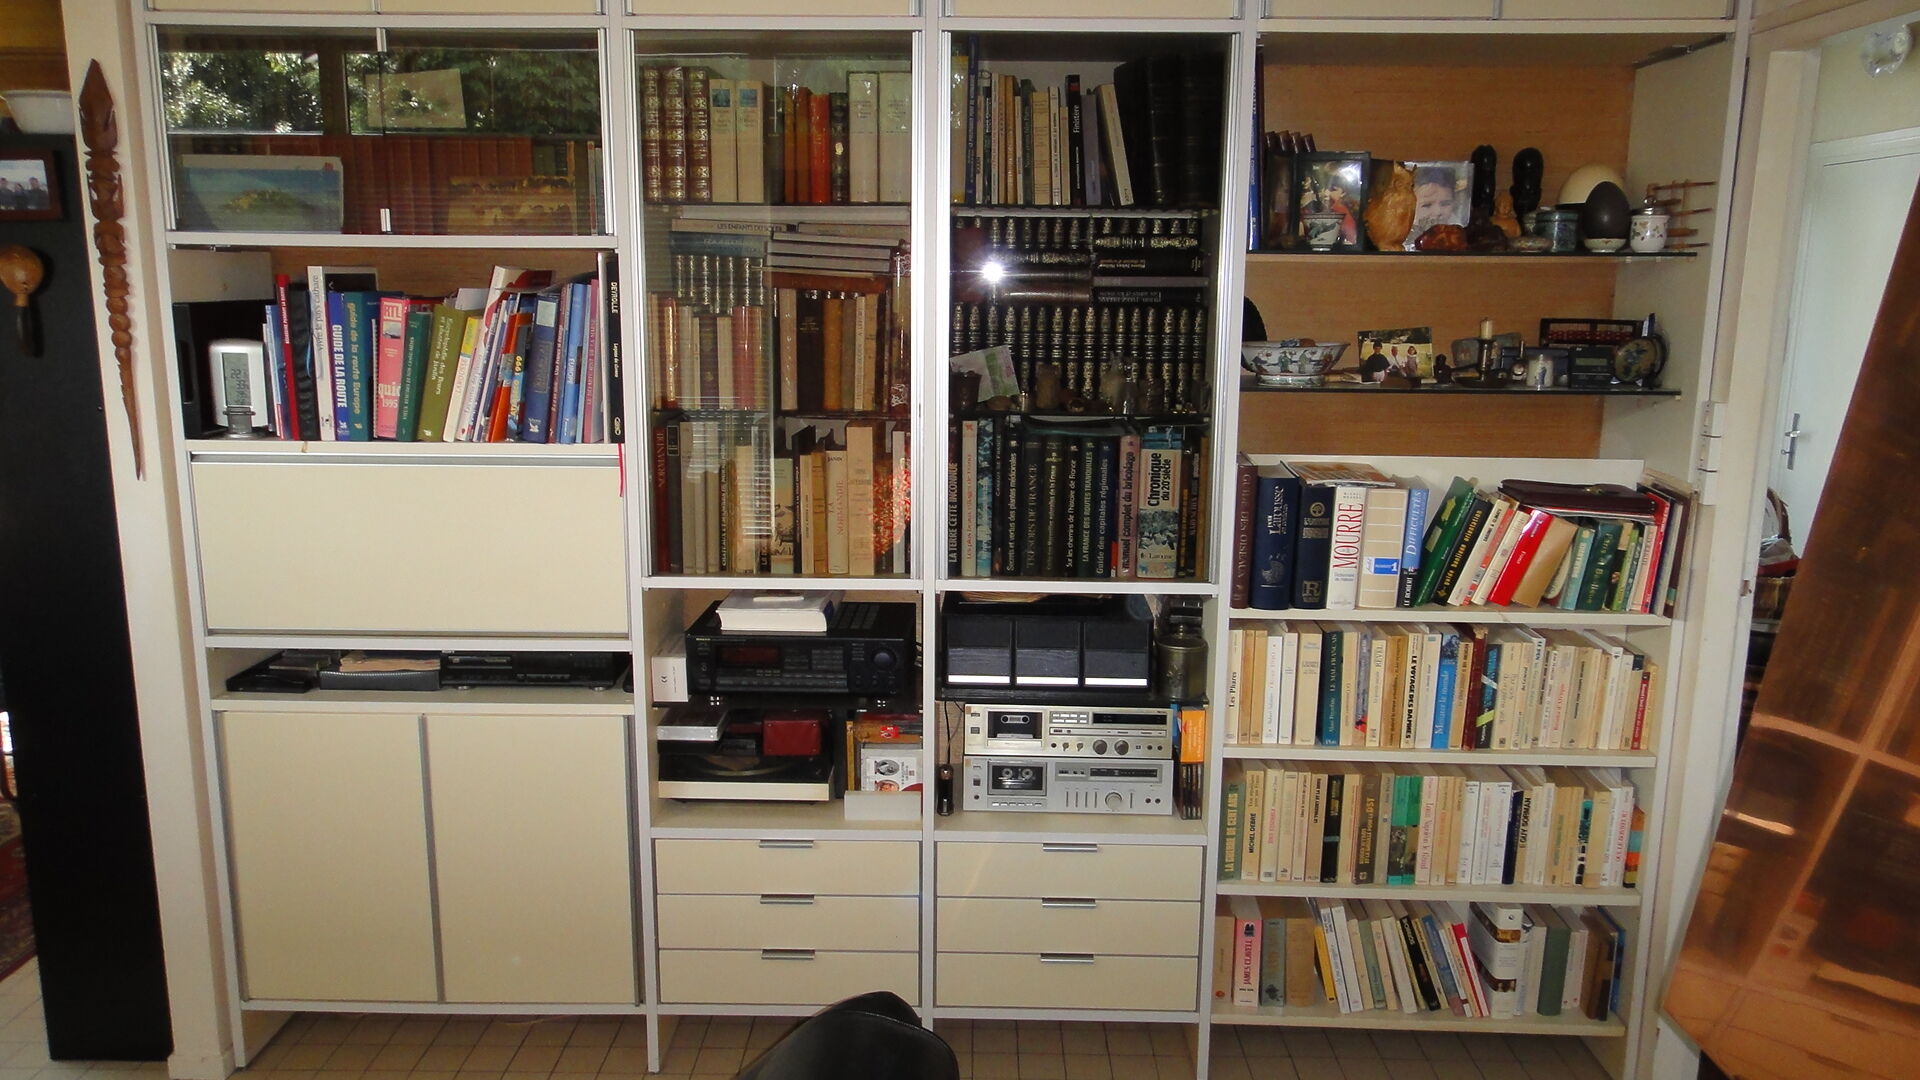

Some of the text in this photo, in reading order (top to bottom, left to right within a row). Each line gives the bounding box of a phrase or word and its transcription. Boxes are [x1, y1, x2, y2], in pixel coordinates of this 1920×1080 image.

[332, 325, 347, 408] GUIDE DE LA ROUTE
[351, 382, 361, 415] Europe
[382, 399, 399, 409] 1995
[1069, 480, 1075, 488] de
[1100, 458, 1109, 498] régionales
[1147, 453, 1162, 507] Chronique
[1161, 459, 1172, 501] du siècle
[948, 463, 958, 562] LA TERRE CETTE INCONNUE
[1008, 511, 1016, 521] des
[1009, 488, 1017, 510] plantes
[1098, 500, 1107, 534] capitales
[1121, 452, 1135, 569] manuel complet du bricolage
[1269, 486, 1284, 535] Larousse
[1240, 511, 1248, 531] DES
[1333, 503, 1364, 568] MOURRE
[1406, 491, 1422, 555] DIFFICULTÉS
[1007, 549, 1015, 571] Secrets
[1082, 554, 1089, 562] LA
[1096, 551, 1104, 574] Guide
[1238, 534, 1248, 578] OISEAUX
[1444, 570, 1455, 586] guide
[1463, 510, 1483, 541] orientation
[1404, 577, 1413, 598] ROBERT
[1411, 656, 1417, 664] LE
[1228, 672, 1237, 708] Les Phares
[1408, 666, 1416, 694] VOYAGE
[1366, 797, 1375, 812] DST
[1520, 797, 1532, 843] GUY SORMAN
[1225, 793, 1238, 871] LA GUERRE DE CENT ANS
[1244, 940, 1252, 985] JAMES CLAVELL
